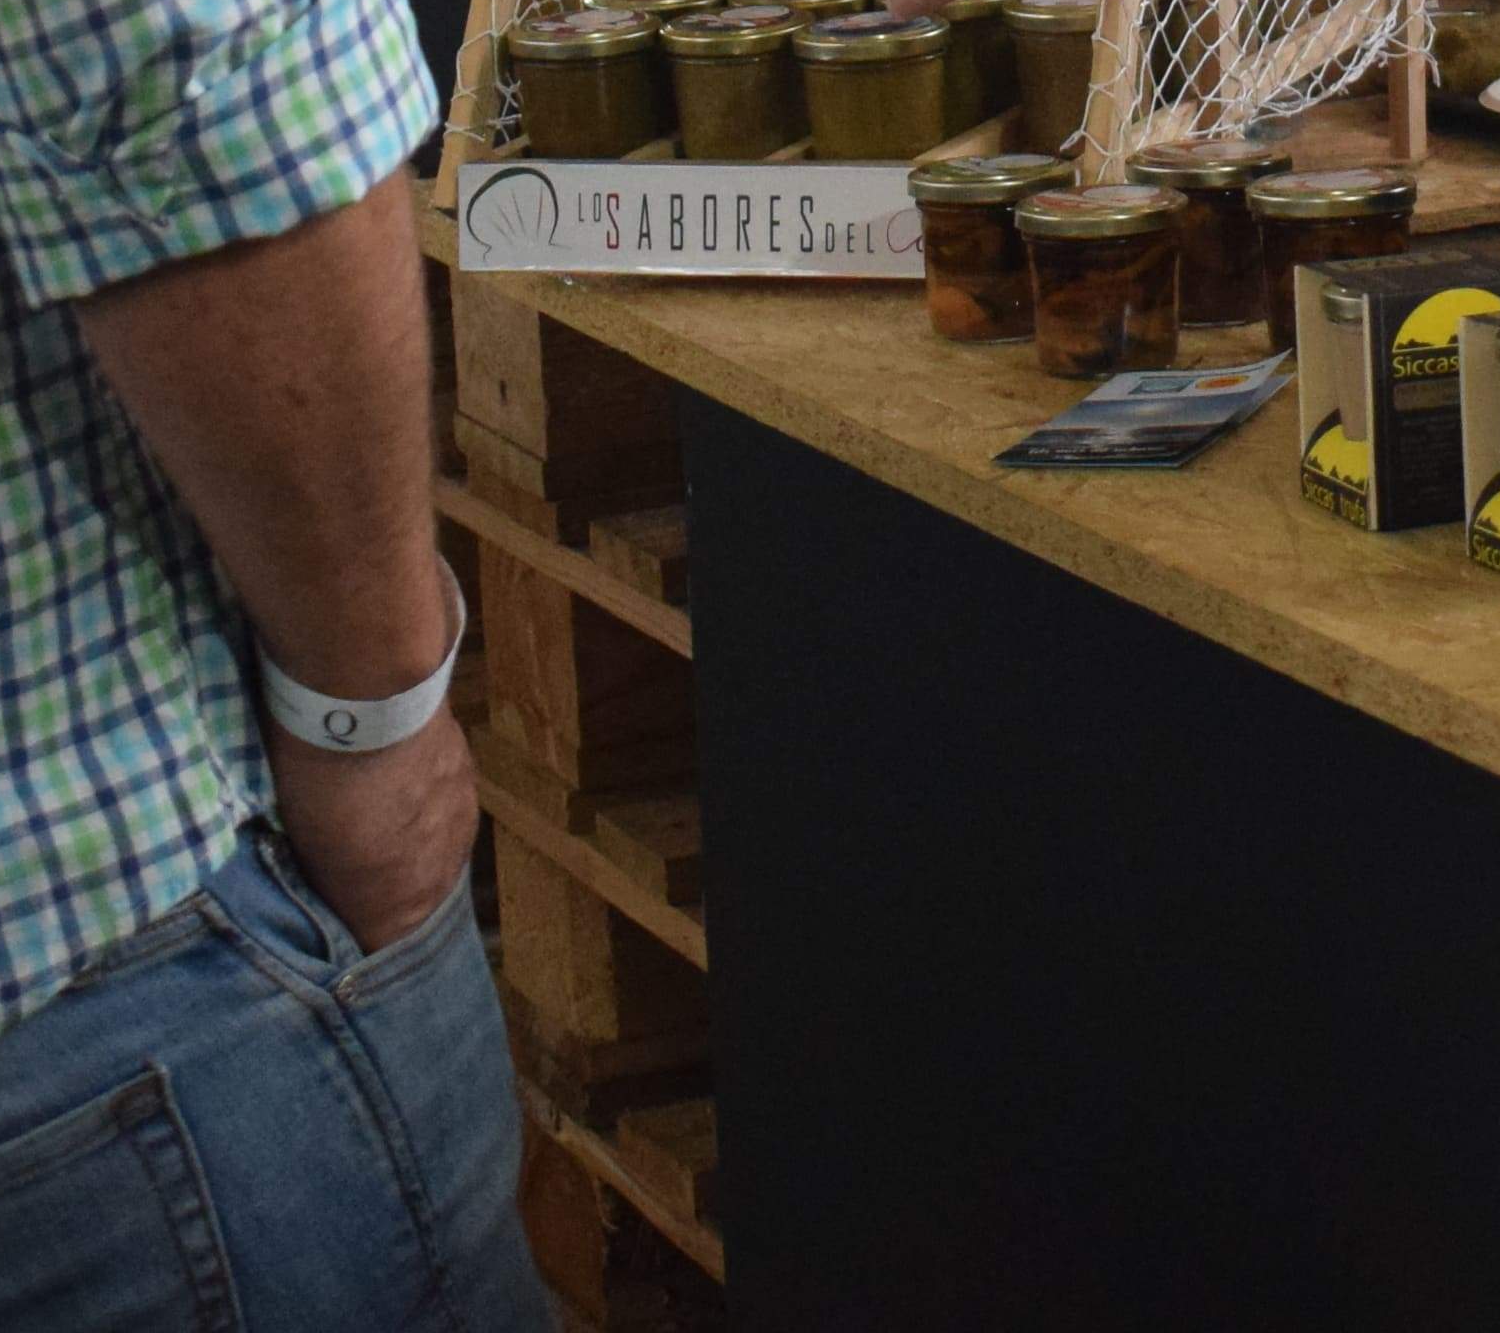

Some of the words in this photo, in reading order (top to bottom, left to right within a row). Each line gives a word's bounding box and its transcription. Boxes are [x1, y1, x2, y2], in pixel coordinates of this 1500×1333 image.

[824, 222, 876, 255] DEL
[1392, 354, 1460, 378] Siccas
[1302, 473, 1335, 512] Siccas
